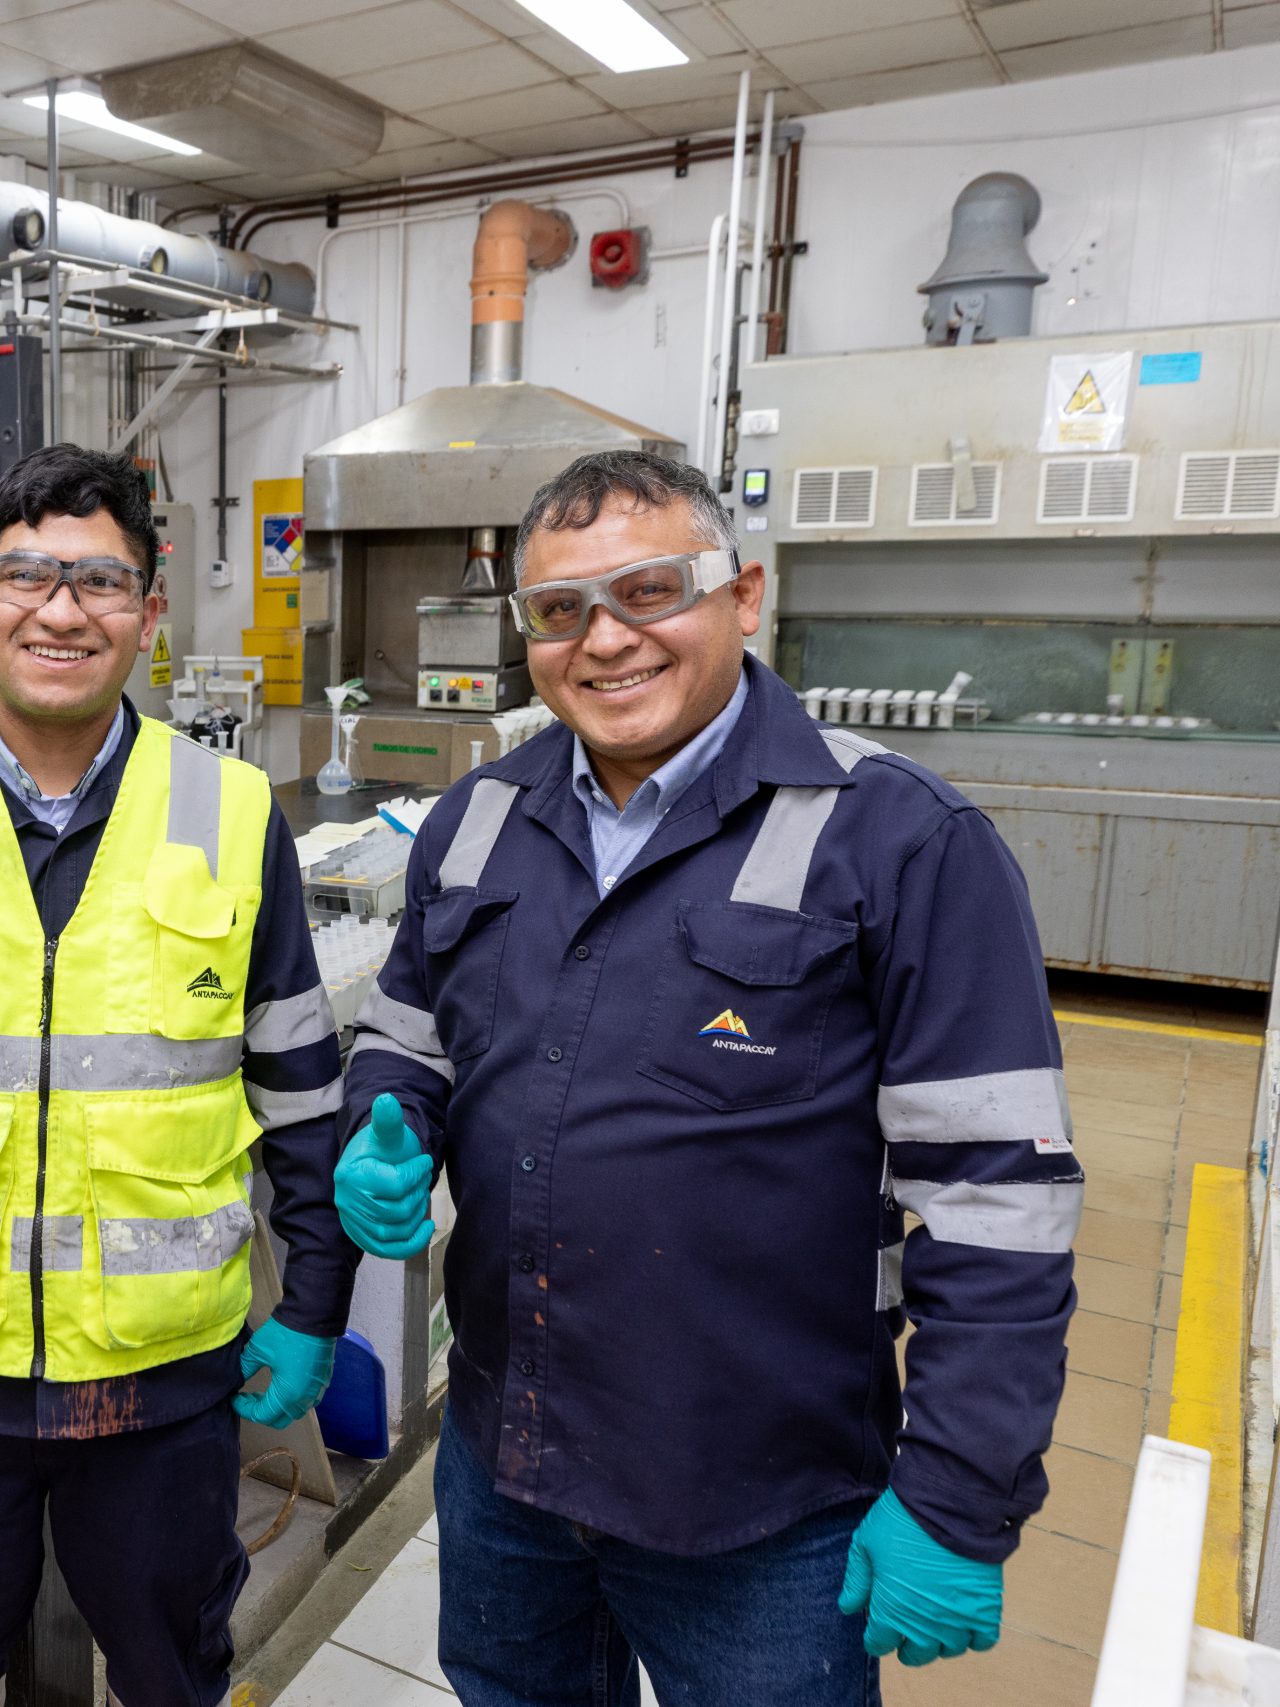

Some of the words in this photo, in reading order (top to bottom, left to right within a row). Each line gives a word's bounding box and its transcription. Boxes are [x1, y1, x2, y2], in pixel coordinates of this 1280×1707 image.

[373, 743, 399, 753] TUBOS
[399, 744, 410, 753] DE
[411, 745, 438, 756] VIDRIO
[192, 990, 235, 1000] ANTAPACCAY
[712, 1039, 777, 1056] ANTAPACCAY
